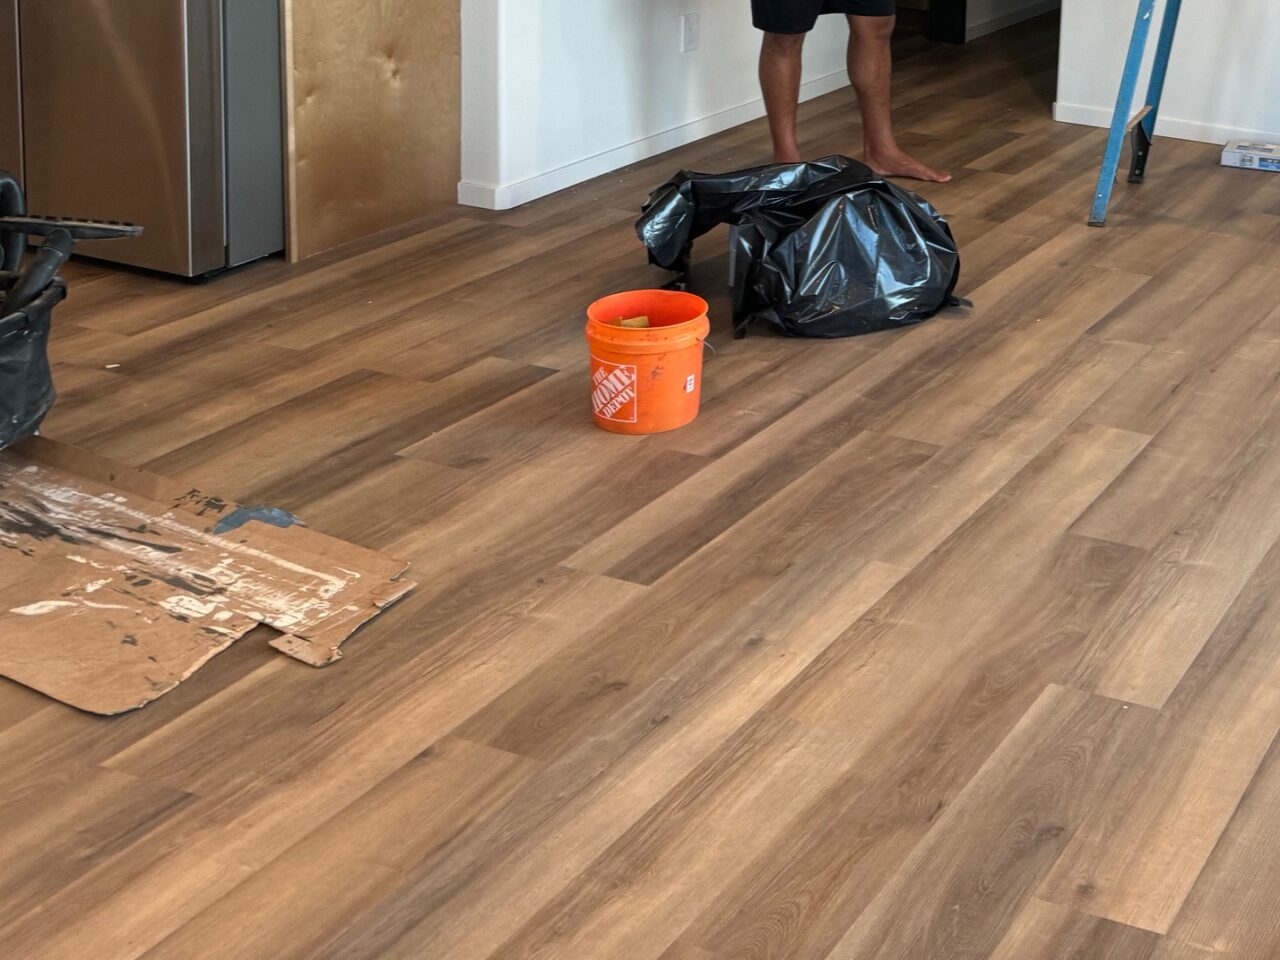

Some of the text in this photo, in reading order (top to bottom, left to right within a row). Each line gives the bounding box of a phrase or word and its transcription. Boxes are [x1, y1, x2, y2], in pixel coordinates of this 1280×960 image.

[592, 366, 634, 414] HOME
[593, 367, 608, 386] THE
[602, 386, 635, 418] DEPOT
